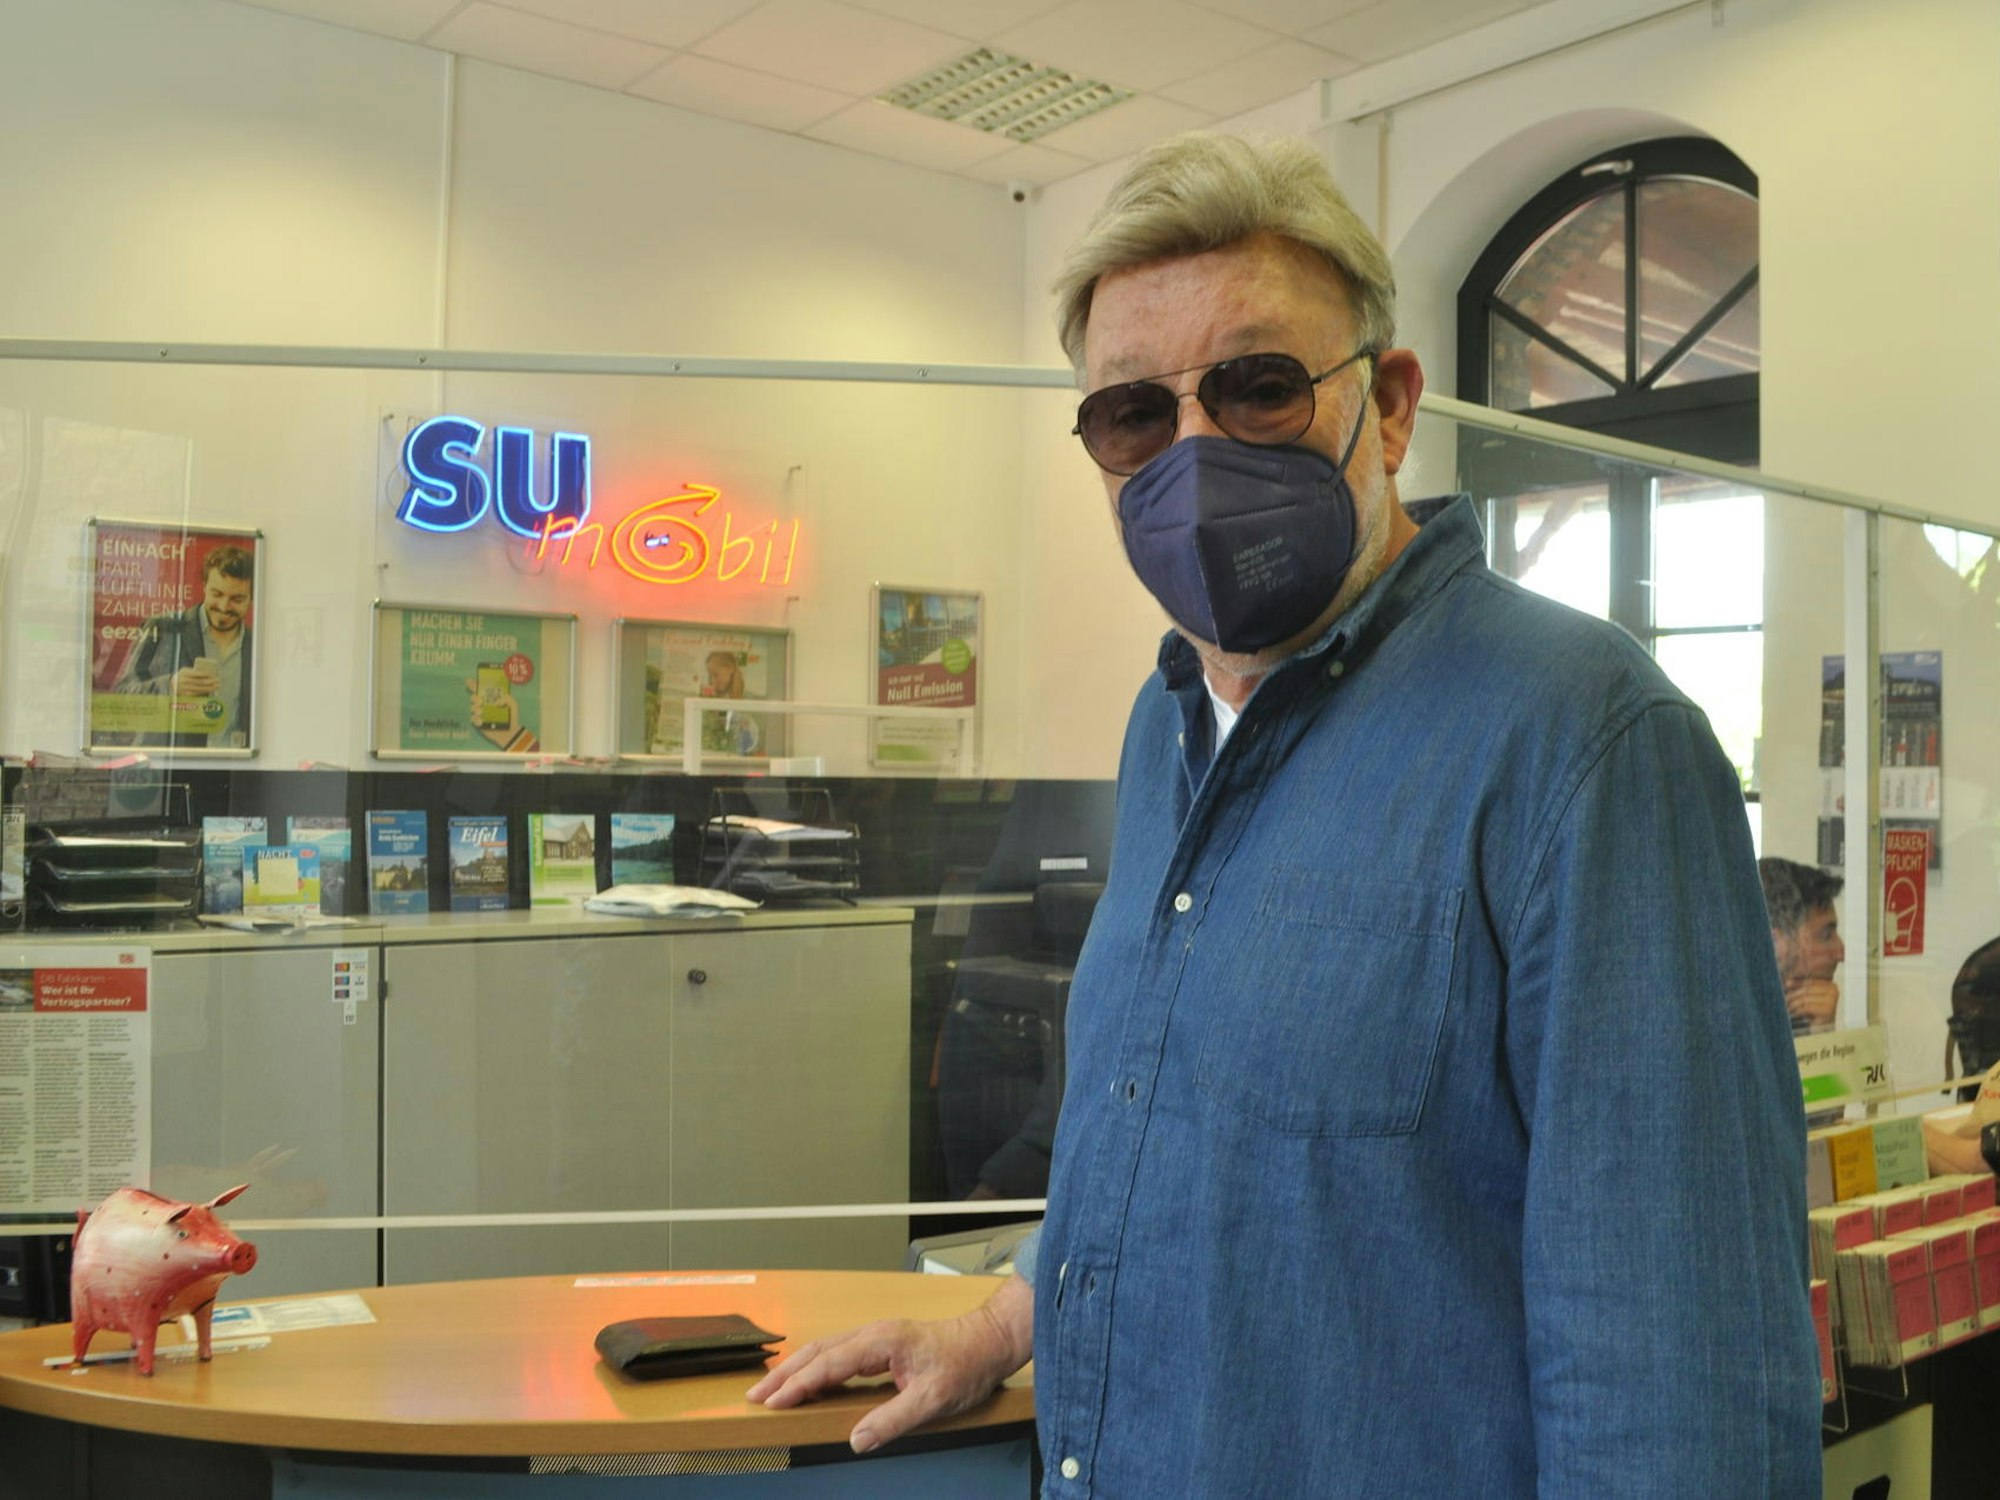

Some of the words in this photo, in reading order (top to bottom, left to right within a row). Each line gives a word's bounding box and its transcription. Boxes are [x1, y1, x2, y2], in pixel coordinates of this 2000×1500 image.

[396, 415, 591, 539] SU
[529, 482, 800, 586] mobil
[102, 538, 186, 561] EINFACH
[102, 561, 142, 577] FAIR
[101, 579, 194, 601] LUFTLINIE
[411, 611, 462, 631] MACHEN
[465, 616, 485, 630] SIE
[410, 631, 435, 648] NUR
[438, 633, 473, 649] EINEN
[476, 635, 518, 651] FINGER
[887, 685, 912, 702] Null
[914, 679, 963, 698] Emission
[460, 821, 500, 847] Eifel
[1886, 834, 1927, 851] MASKEN-
[1886, 854, 1922, 872] PFLICHT
[41, 985, 62, 996] Wer
[64, 985, 78, 995] ist
[80, 985, 96, 995] Ihr
[41, 995, 132, 1008] Vertragspartner?
